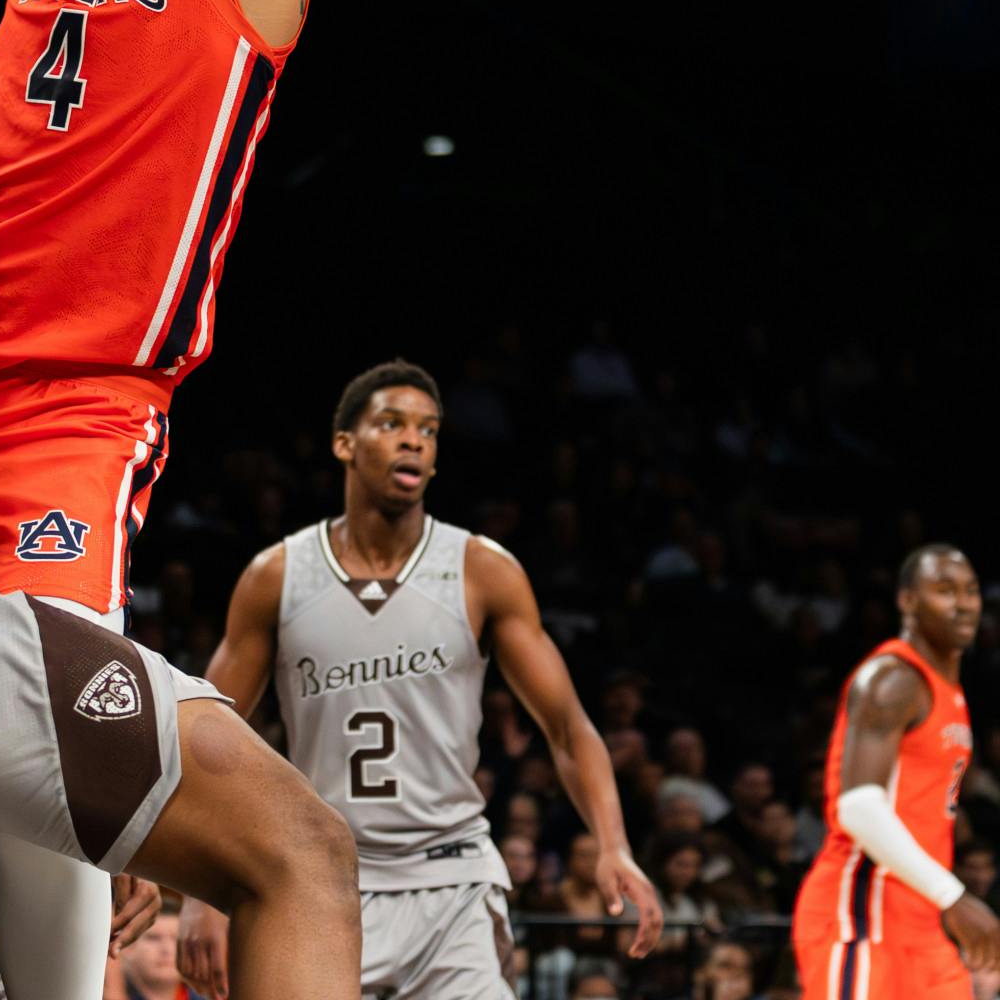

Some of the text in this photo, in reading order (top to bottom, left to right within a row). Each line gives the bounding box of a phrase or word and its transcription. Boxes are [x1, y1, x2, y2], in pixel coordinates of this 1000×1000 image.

[25, 8, 88, 131] 4
[297, 645, 454, 698] Bonnies
[345, 711, 400, 801] 2
